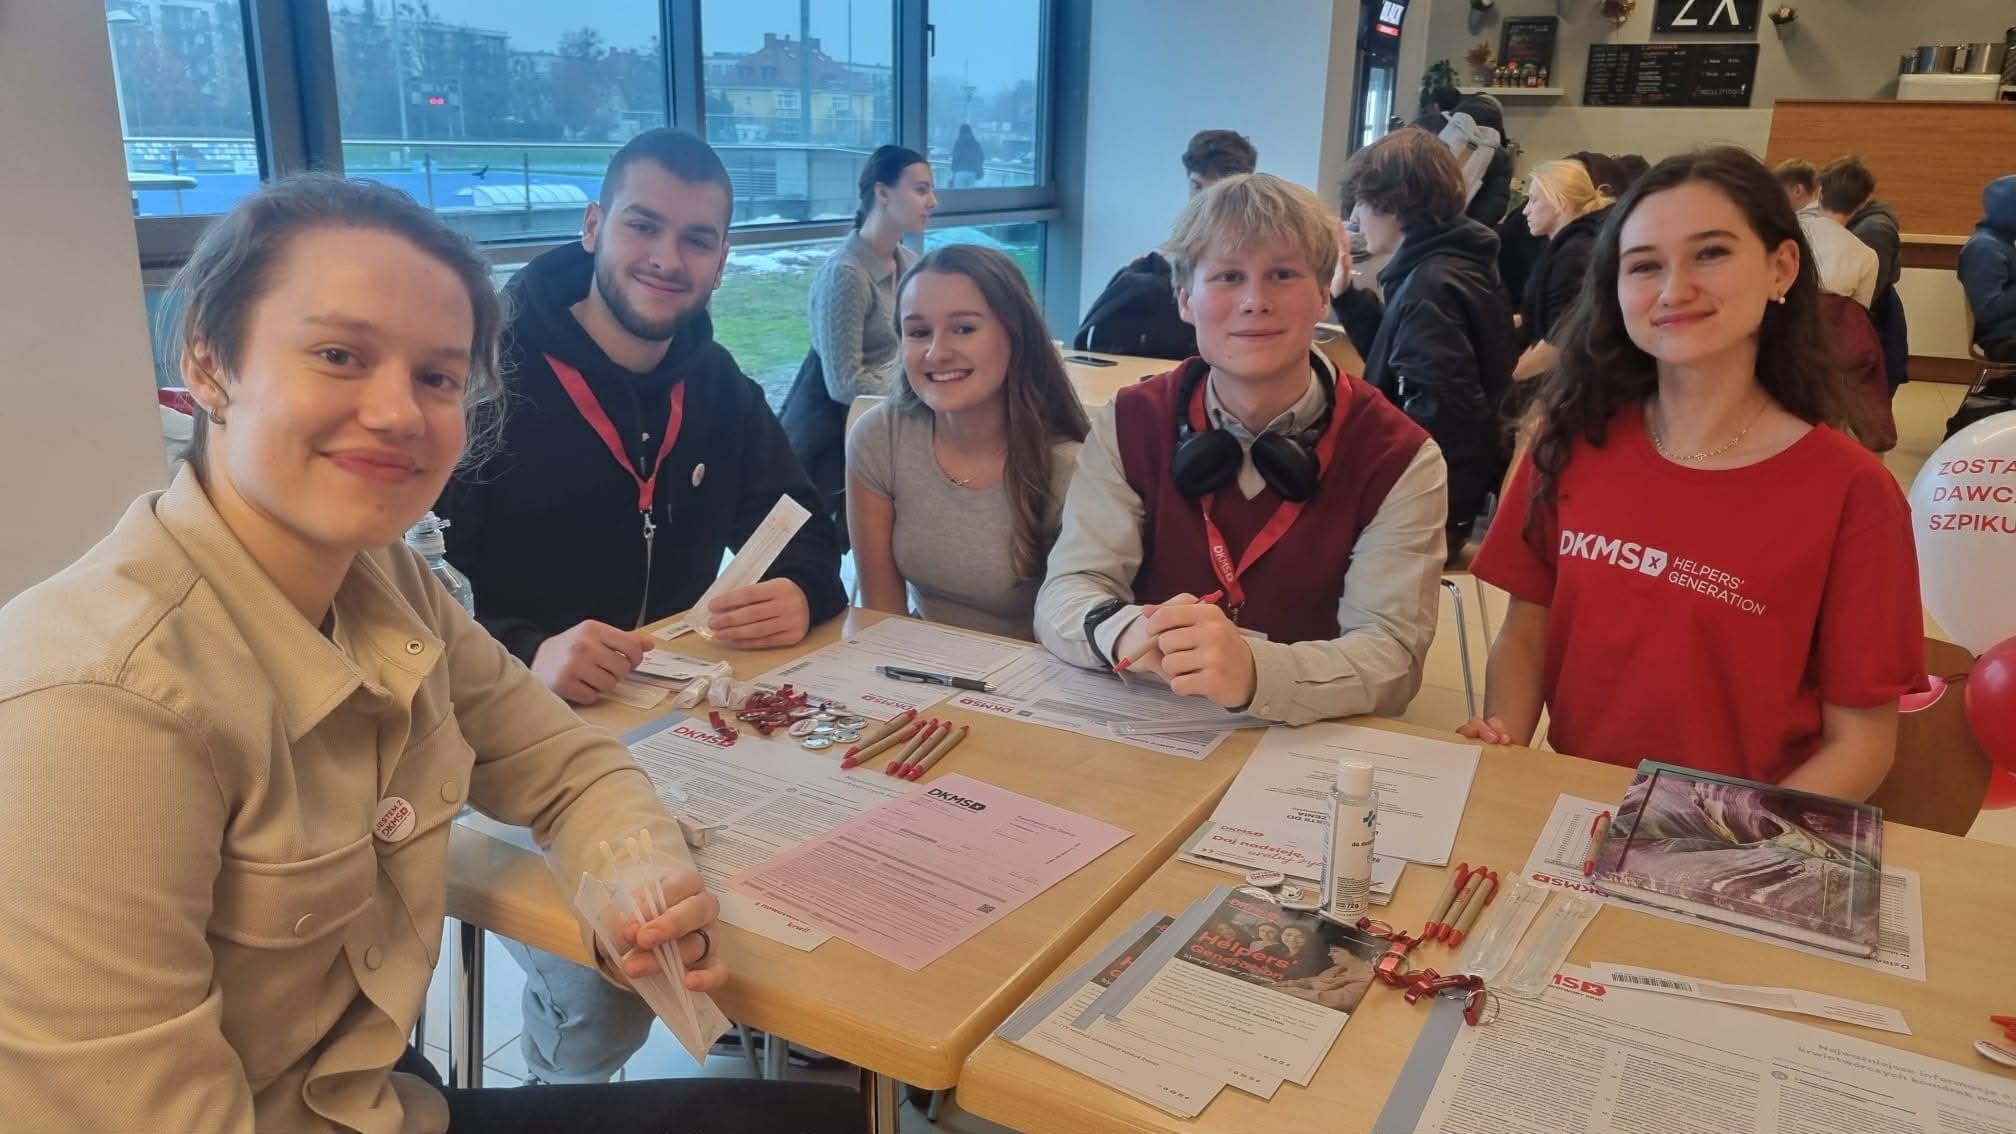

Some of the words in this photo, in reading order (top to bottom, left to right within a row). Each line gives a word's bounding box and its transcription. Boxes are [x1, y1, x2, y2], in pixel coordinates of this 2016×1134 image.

[1932, 486, 2016, 504] DAWC
[1929, 514, 2016, 534] SZPIKU
[1559, 530, 1643, 570] DKMS
[1668, 571, 1766, 616] GENERATION
[974, 700, 1016, 714] DKMS
[672, 726, 720, 744] DKMS
[927, 788, 972, 808] DKMS
